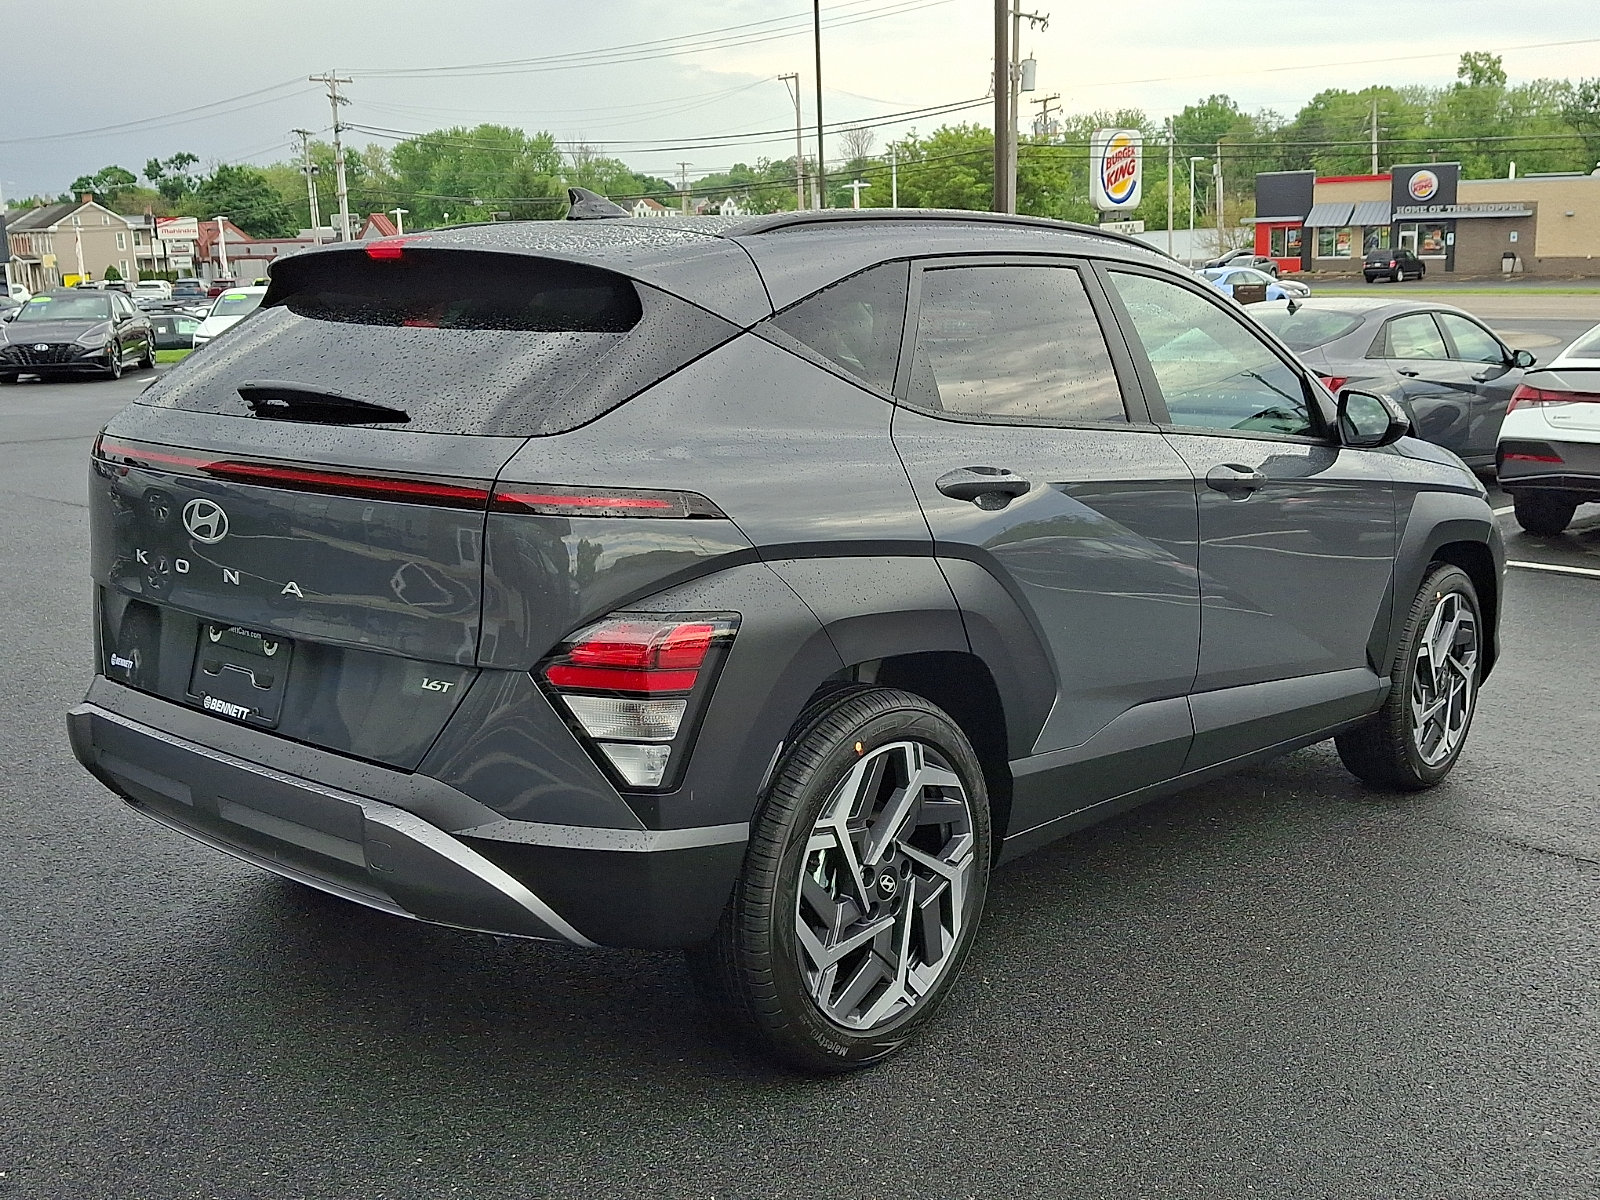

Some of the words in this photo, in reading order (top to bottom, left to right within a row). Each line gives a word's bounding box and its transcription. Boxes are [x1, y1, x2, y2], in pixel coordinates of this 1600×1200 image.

[1106, 146, 1136, 171] BURGER
[1106, 159, 1136, 190] KING
[1396, 205, 1427, 214] HOME
[1429, 204, 1442, 213] OF
[1443, 204, 1469, 213] THE
[136, 548, 304, 599] KONA
[210, 699, 250, 720] BENNETT
